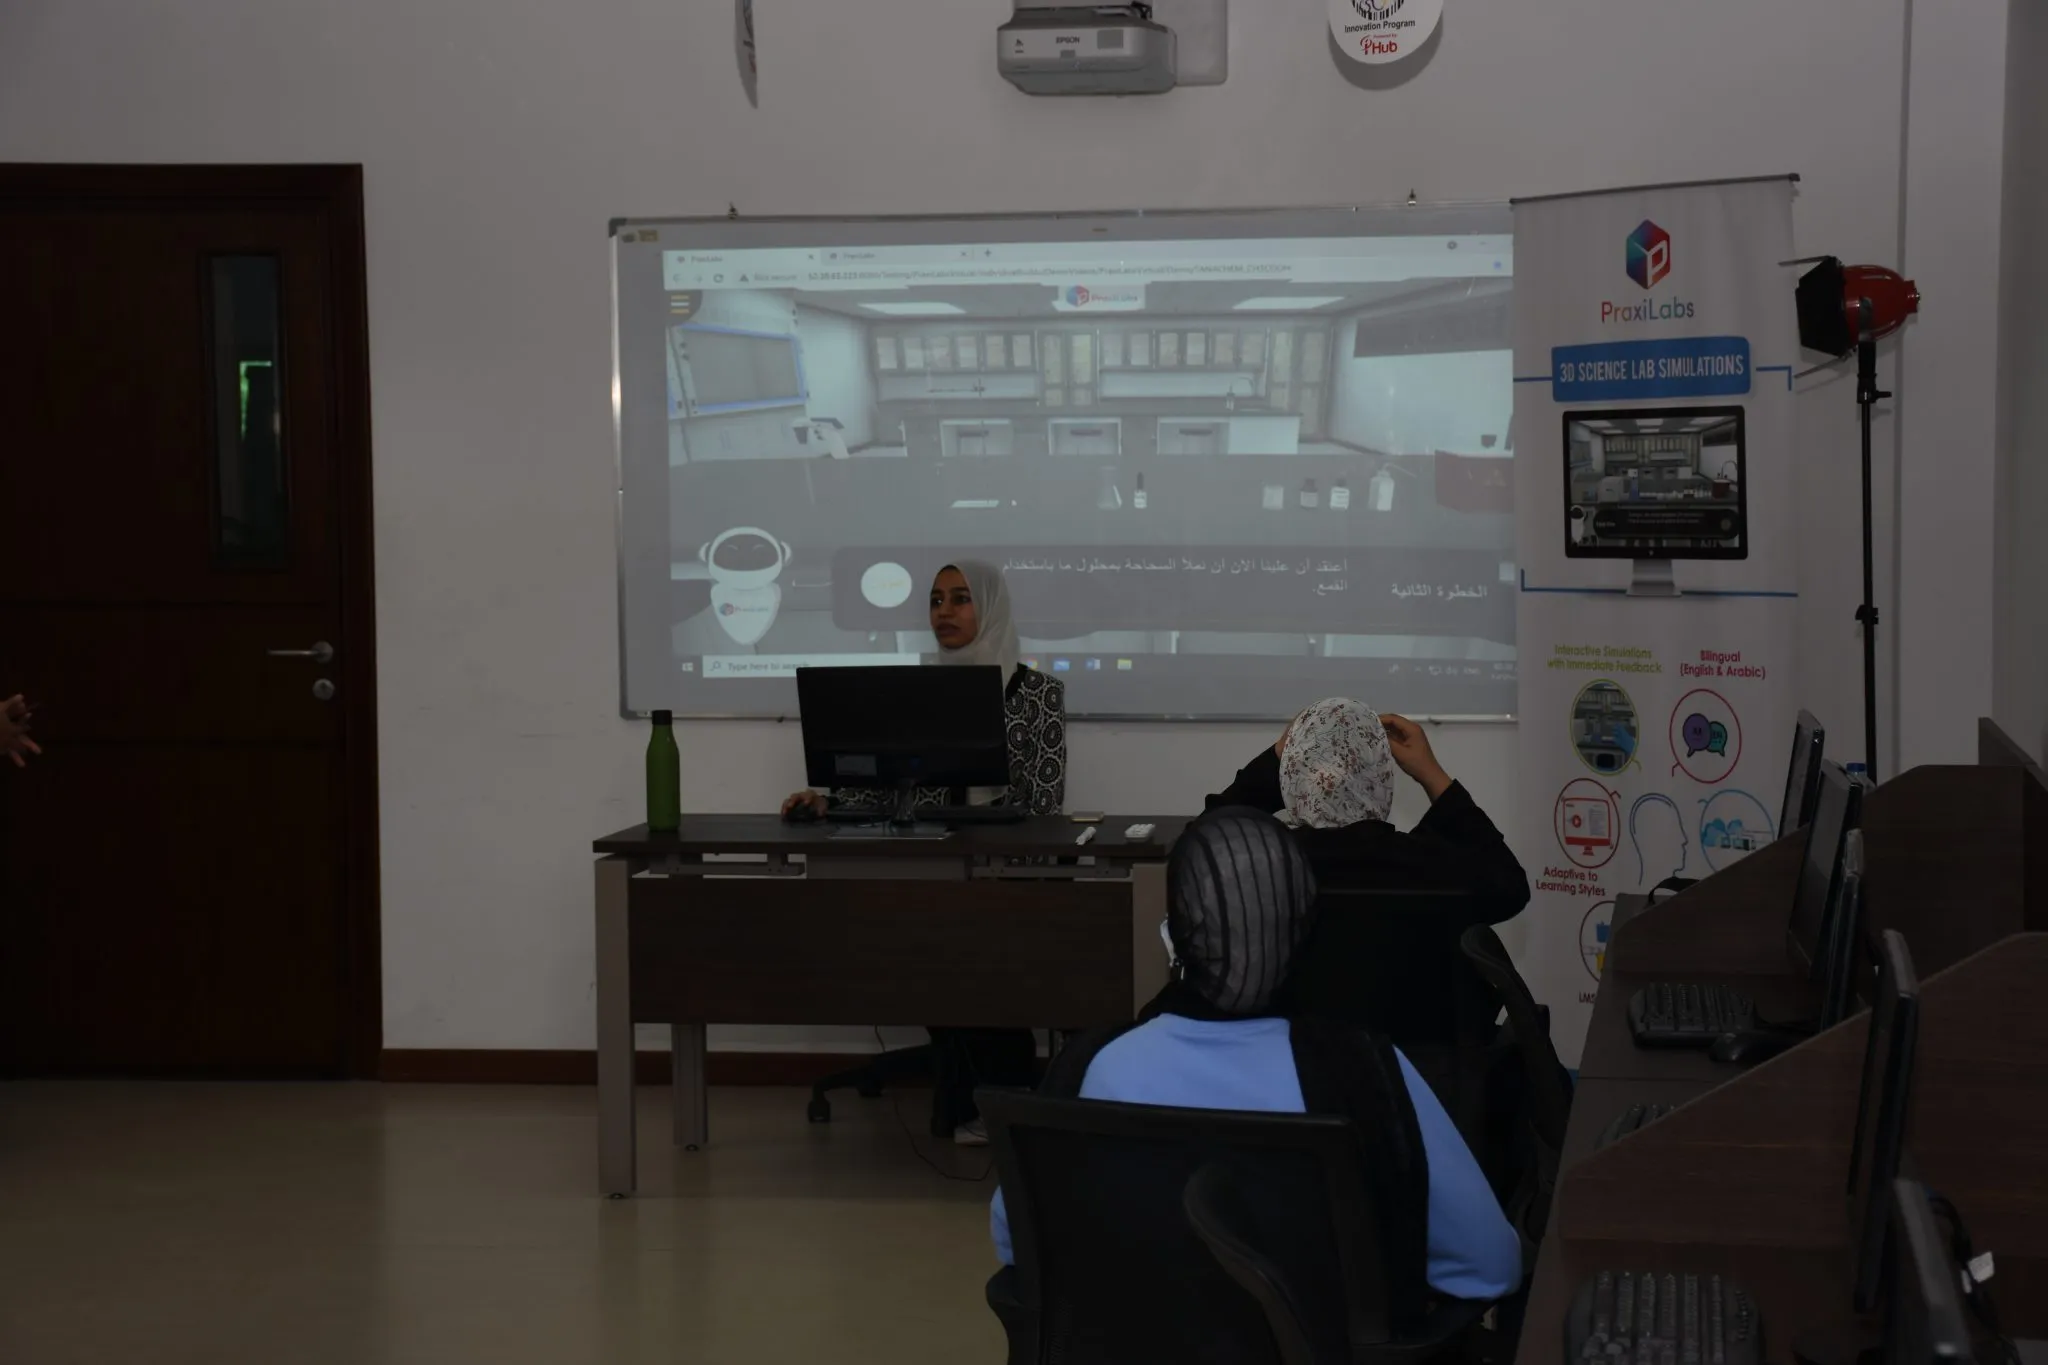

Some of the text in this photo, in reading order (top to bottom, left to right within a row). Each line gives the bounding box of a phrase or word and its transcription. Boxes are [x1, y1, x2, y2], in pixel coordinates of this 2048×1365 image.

[1344, 19, 1416, 33] Innovation Program
[1056, 36, 1080, 44] EPSON
[1601, 296, 1694, 323] PraxiLabs
[1559, 354, 1744, 383] 3D SCIENCE LAB SIMULATIONS
[1059, 557, 1072, 571] ما
[1076, 556, 1122, 574] بمحلول
[1391, 582, 1488, 601] الخطوة الثانية
[1555, 643, 1653, 659] Interactive Simulations
[1700, 650, 1741, 665] Bilingual
[1567, 659, 1614, 671] Immediate
[1616, 661, 1662, 673] Feedback
[1680, 663, 1766, 680] (English & Arabic)
[1543, 866, 1598, 882] Adaptive to
[1535, 879, 1605, 897] Learning Styles
